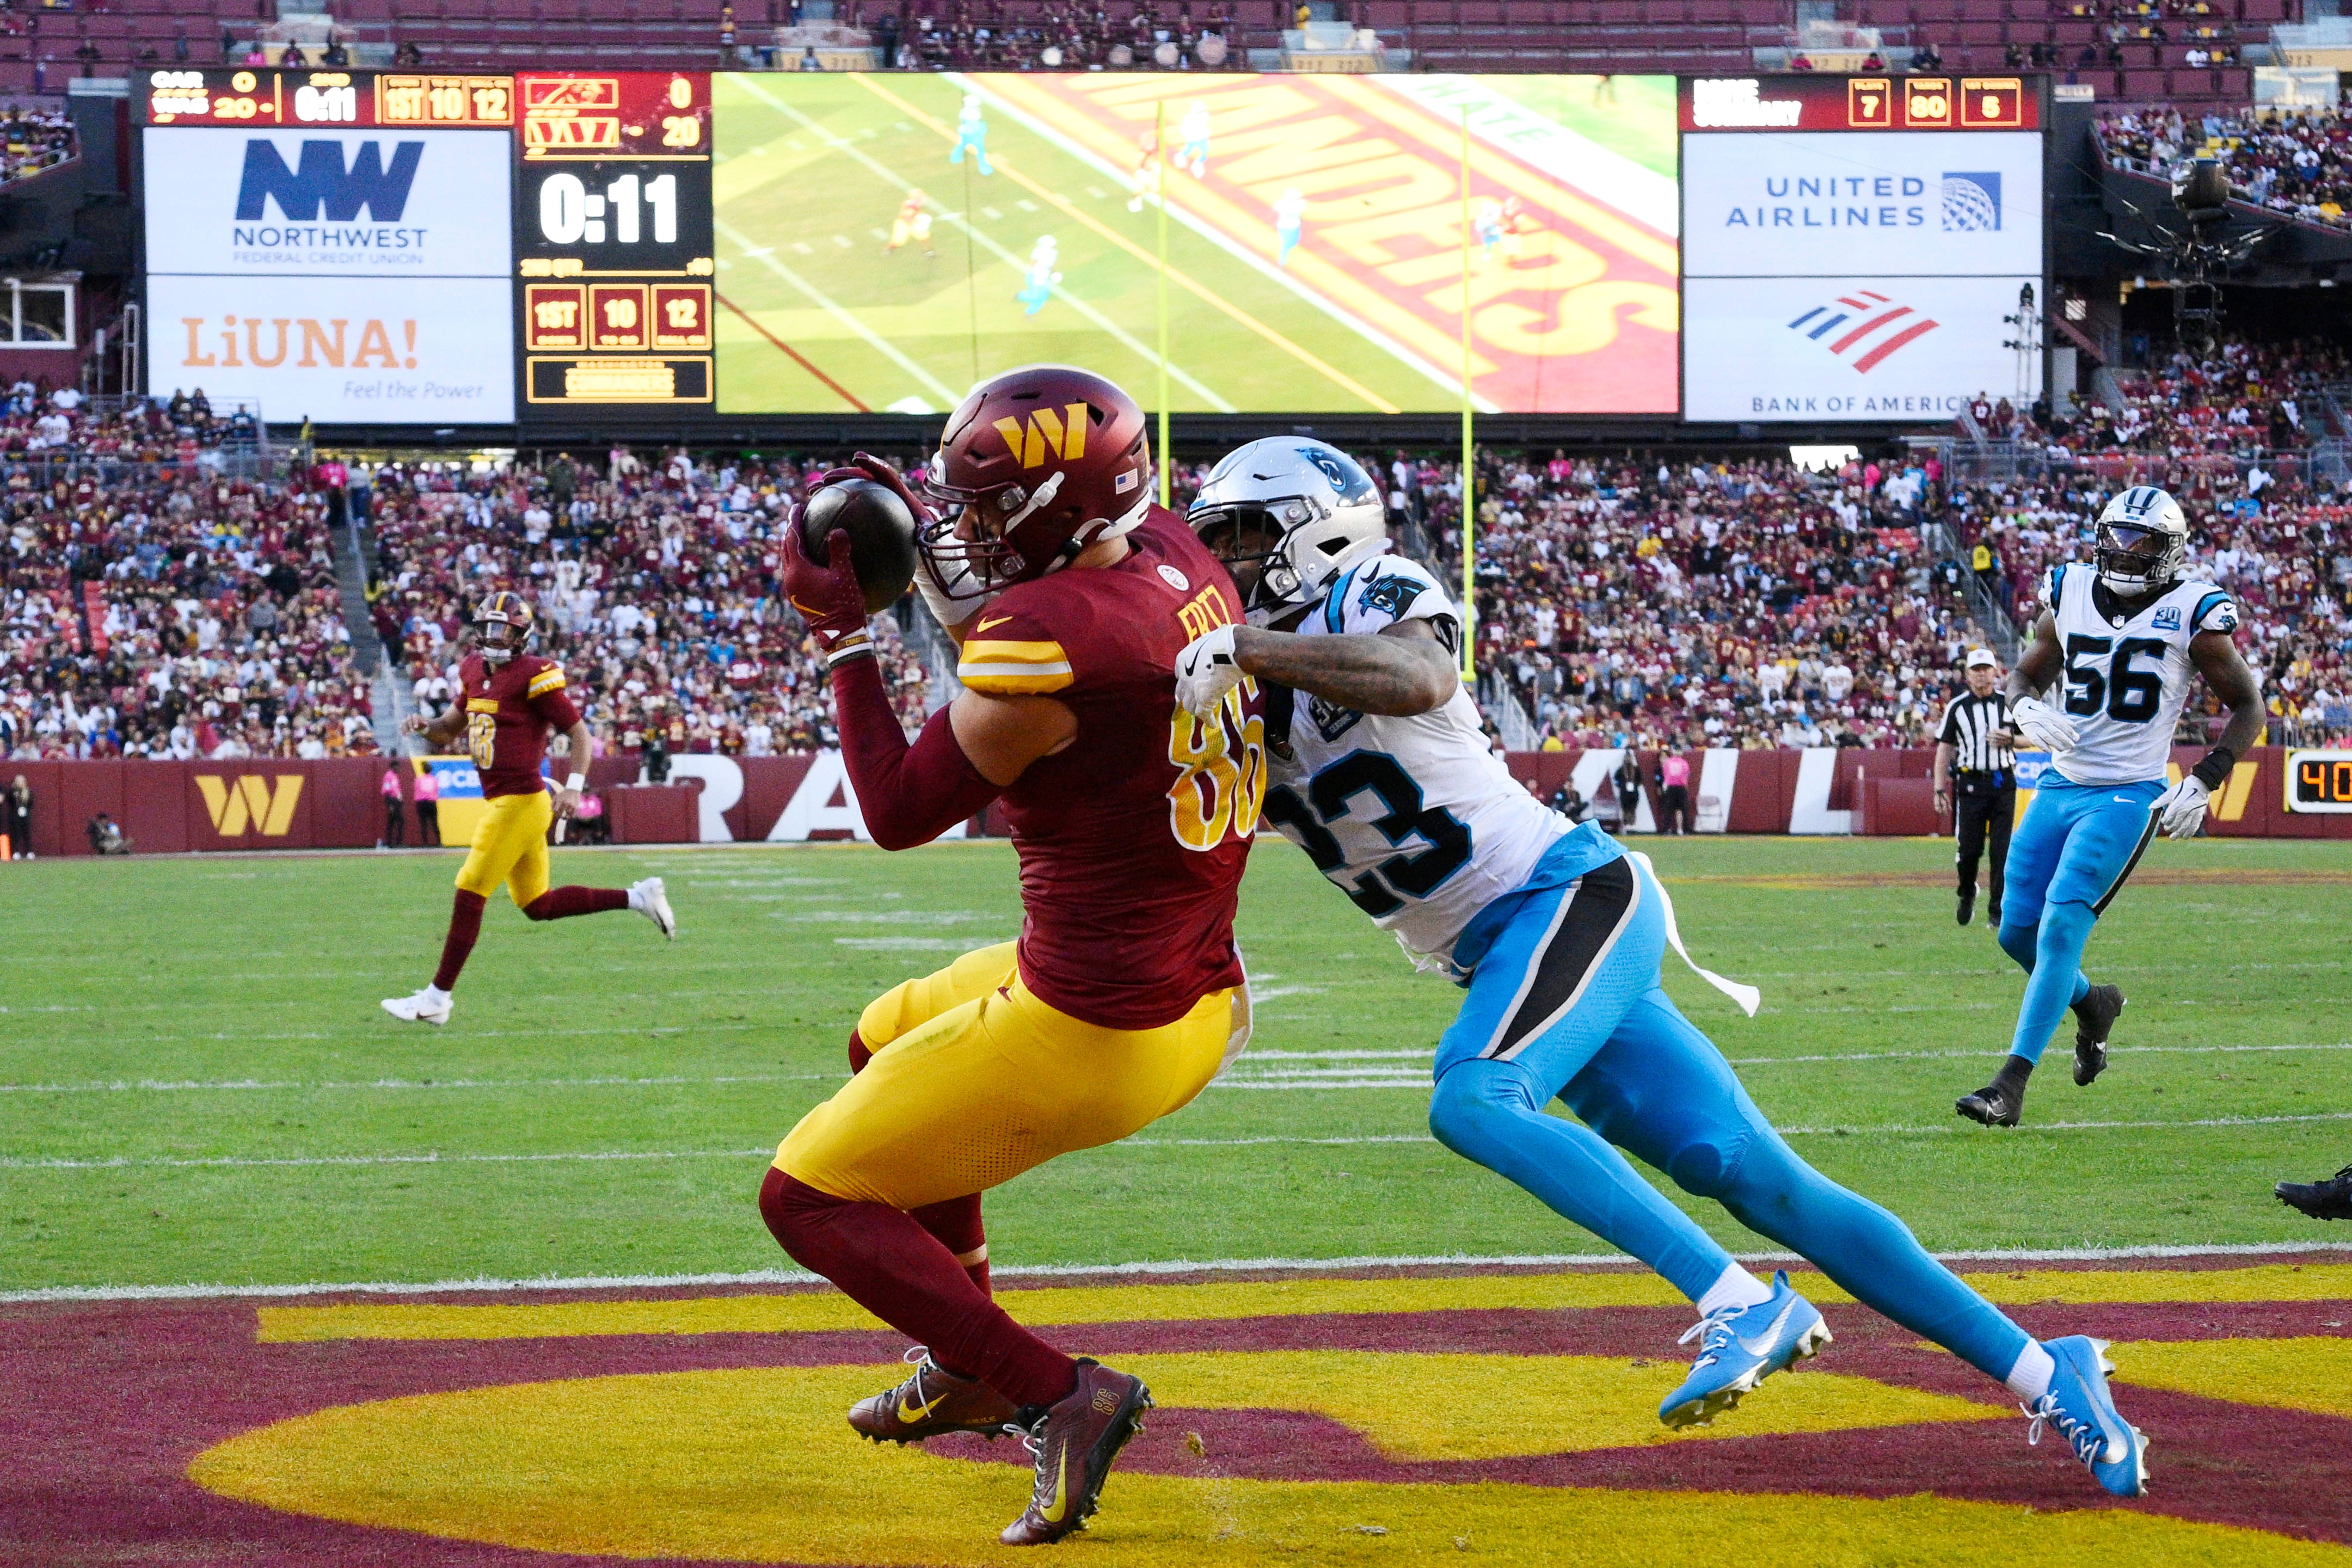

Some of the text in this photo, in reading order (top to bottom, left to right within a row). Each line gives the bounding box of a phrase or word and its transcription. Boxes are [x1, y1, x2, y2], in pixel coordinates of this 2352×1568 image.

[232, 71, 256, 93] 0
[670, 78, 691, 109] 0
[213, 97, 257, 119] 20
[294, 86, 356, 121] 0:11
[385, 88, 424, 119] 1ST
[428, 88, 463, 119] 10
[472, 88, 507, 120] 12
[1861, 96, 1879, 118] 7
[1910, 95, 1946, 119] 80
[1981, 96, 2000, 119] 5
[662, 116, 700, 146] 20
[233, 139, 425, 222] NW
[1767, 177, 1924, 196] UNITED
[540, 173, 677, 244] 0:11
[1725, 207, 1925, 226] AIRLINES
[233, 227, 428, 248] NORTHWEST
[232, 251, 423, 265] FEDERAL CREDIT UNION
[535, 301, 578, 328] 1ST
[604, 299, 637, 328] 10
[665, 299, 697, 328] 12
[181, 314, 417, 370] LiUNA!
[343, 380, 483, 398] Feel the Power
[1753, 397, 1816, 412] BANK
[1827, 397, 1854, 412] OF
[992, 402, 1088, 469] W
[2157, 607, 2181, 623] 30
[2065, 633, 2167, 723] 56
[1168, 675, 1267, 851] 86
[452, 770, 482, 788] CB
[2303, 761, 2352, 802] 40
[194, 774, 304, 837] W
[1261, 748, 1472, 919] 23
[1092, 1388, 1120, 1415] 86
